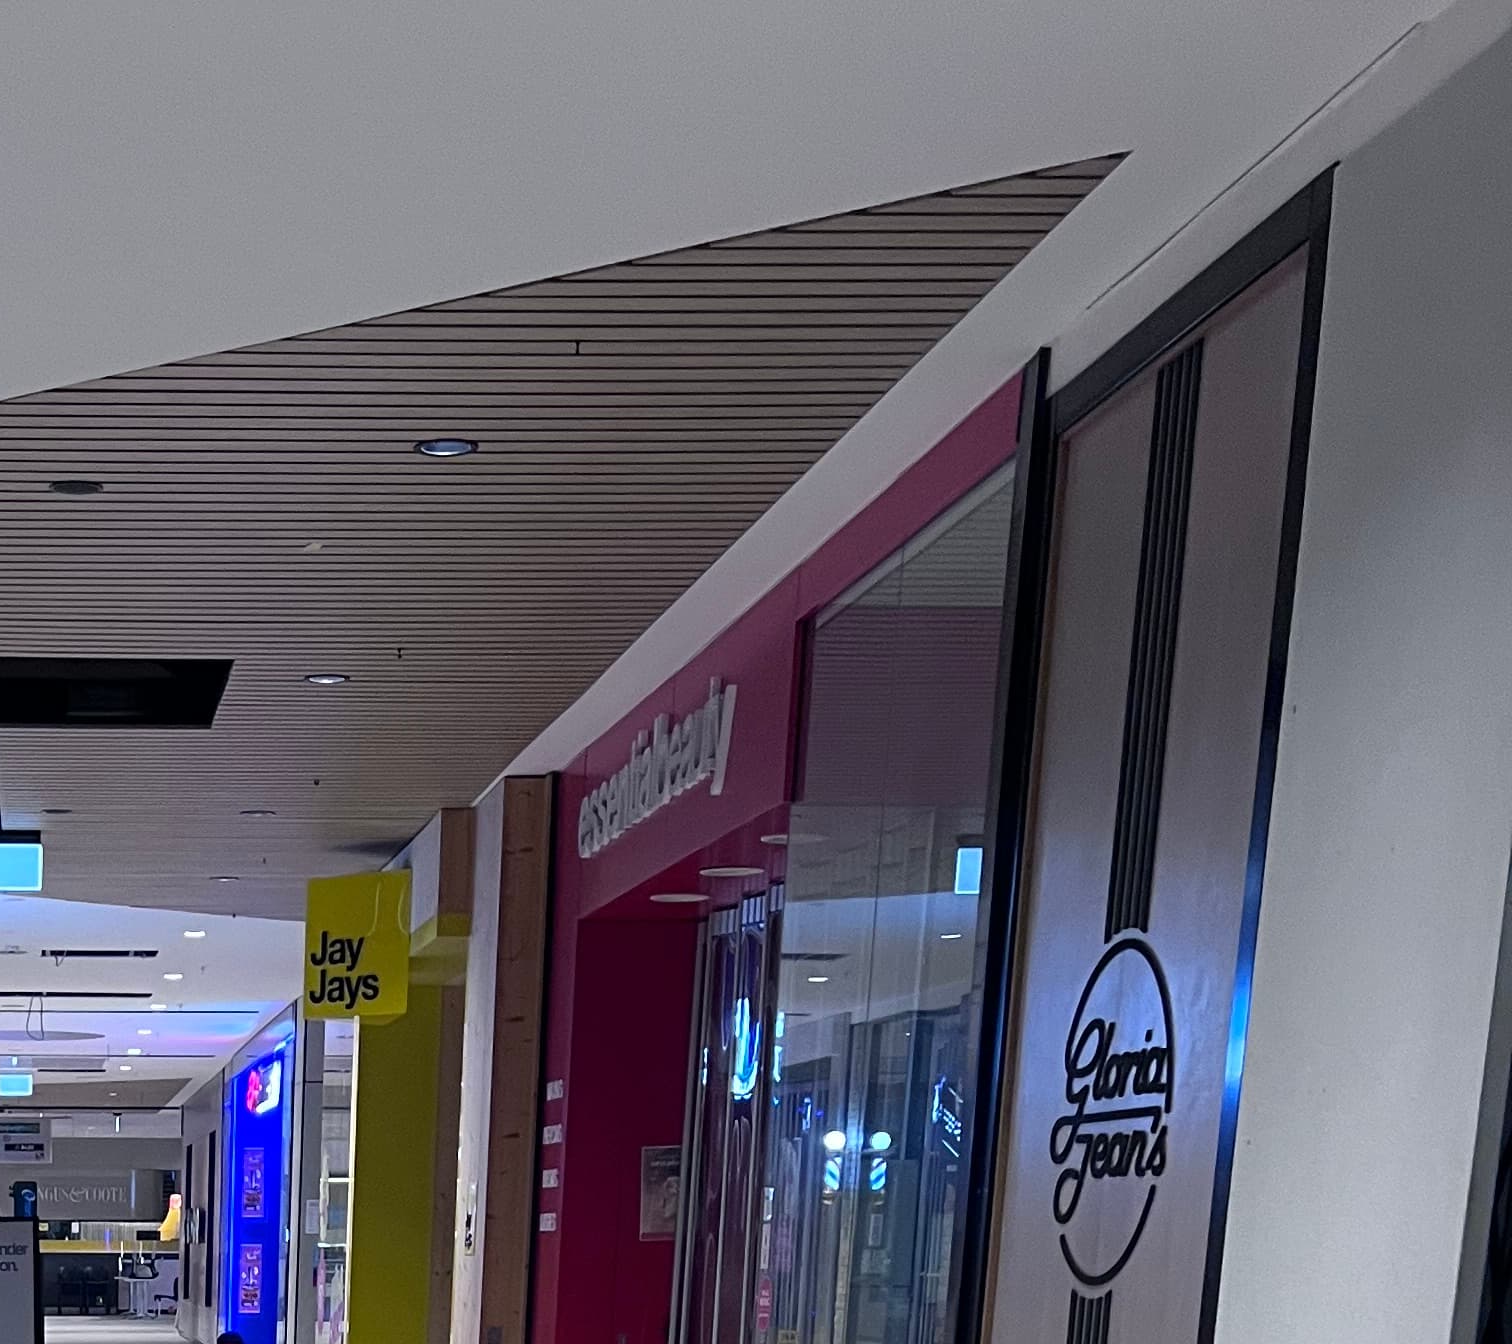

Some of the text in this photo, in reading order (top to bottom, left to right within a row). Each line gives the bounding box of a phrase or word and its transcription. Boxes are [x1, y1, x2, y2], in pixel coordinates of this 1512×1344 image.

[310, 931, 365, 972] Jay
[309, 969, 380, 1010] Jays
[1057, 1018, 1171, 1130] Gloria
